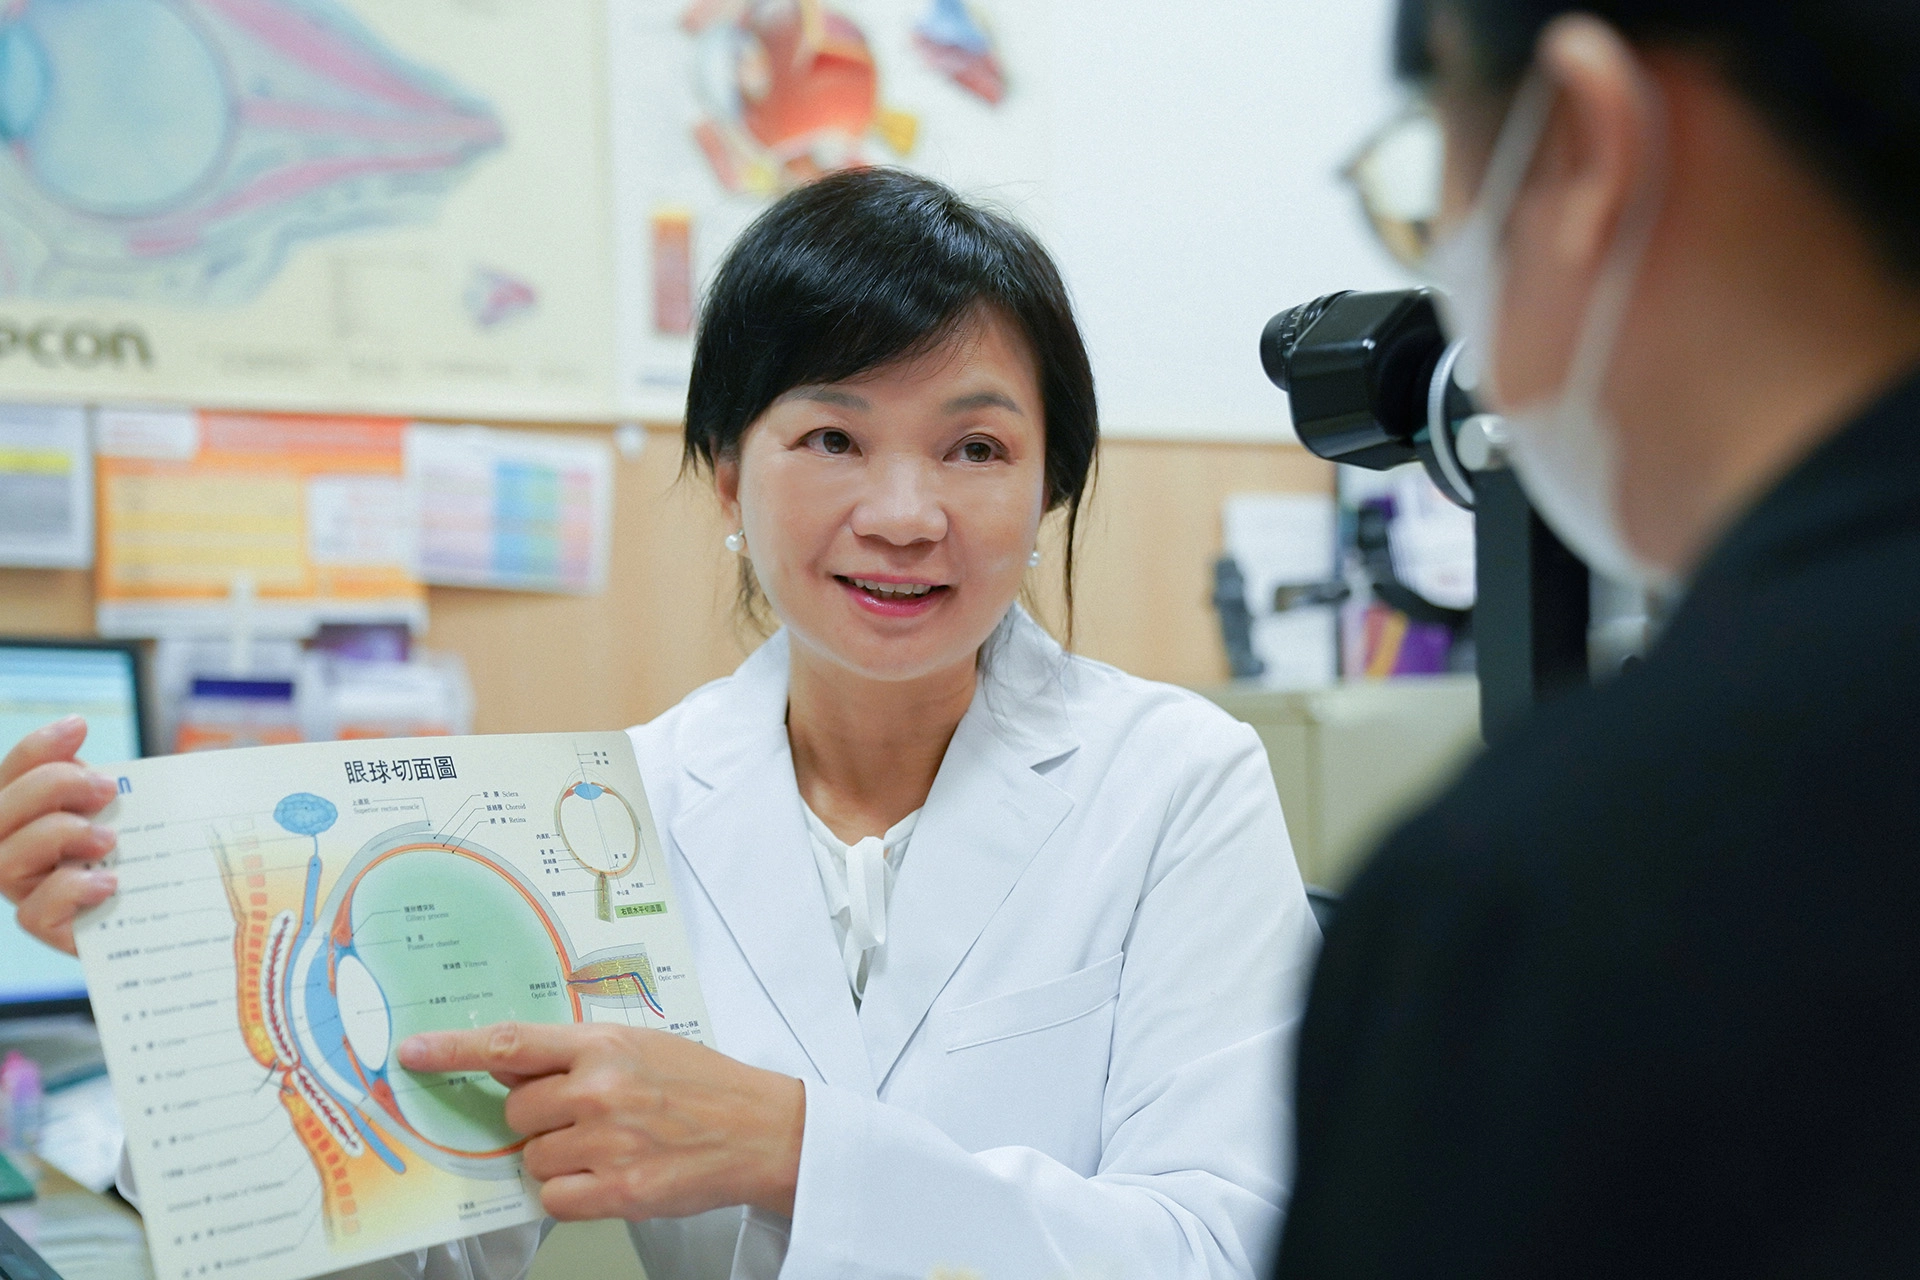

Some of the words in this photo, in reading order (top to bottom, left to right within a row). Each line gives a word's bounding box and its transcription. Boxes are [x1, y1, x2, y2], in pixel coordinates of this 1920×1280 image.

[344, 755, 458, 784] 眼球切面圖
[502, 790, 519, 798] Sclera
[505, 802, 527, 811] Choroid
[509, 816, 527, 824] Retina
[658, 973, 674, 982] Optic
